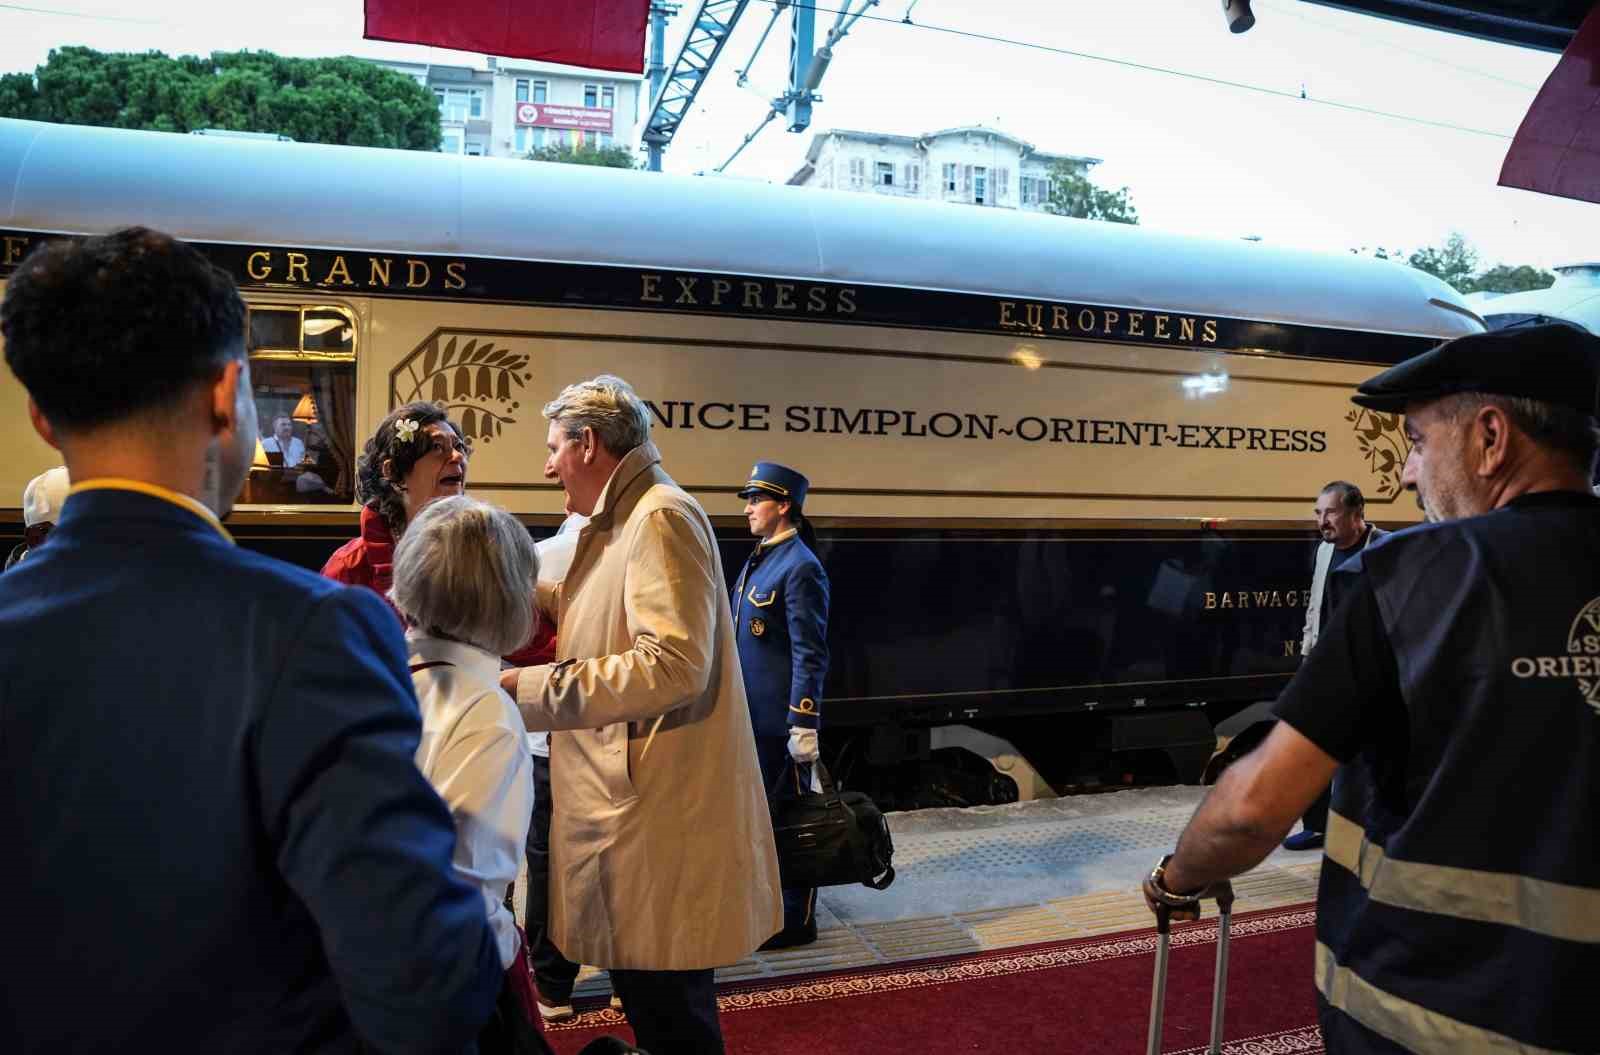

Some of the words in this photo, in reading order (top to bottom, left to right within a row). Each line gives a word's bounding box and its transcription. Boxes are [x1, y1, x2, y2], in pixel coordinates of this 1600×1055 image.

[247, 252, 467, 289] GRANDS
[640, 274, 857, 313] EXPRESS
[999, 302, 1217, 343] EUROPEENS
